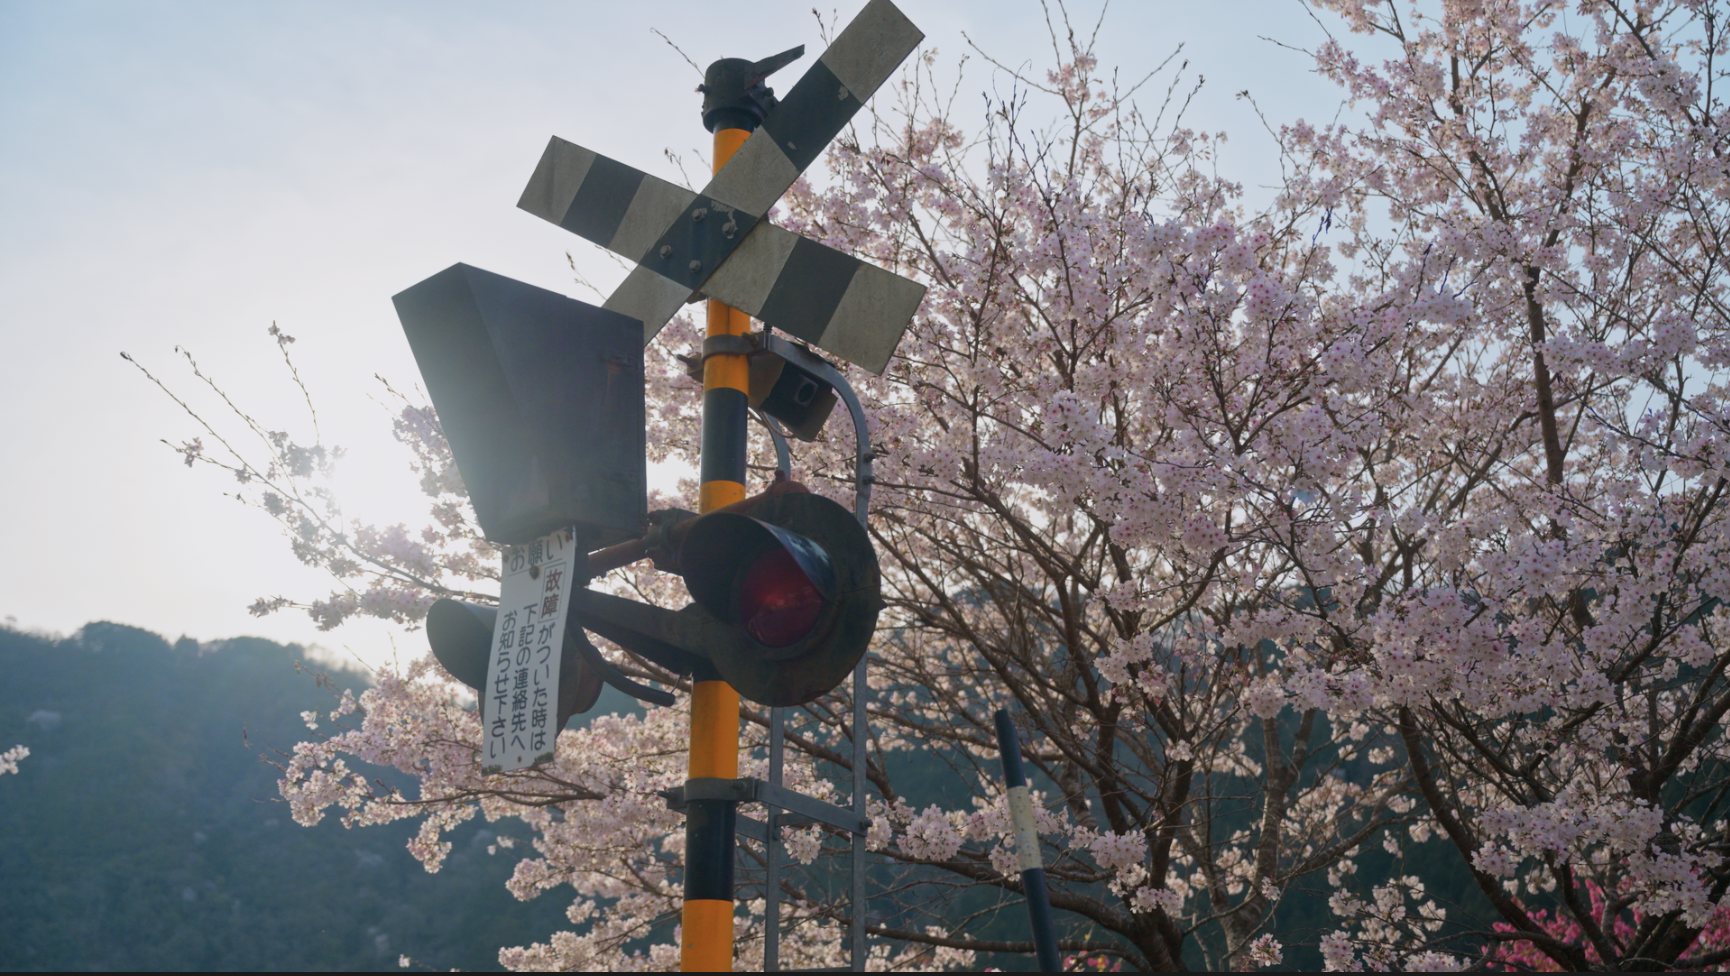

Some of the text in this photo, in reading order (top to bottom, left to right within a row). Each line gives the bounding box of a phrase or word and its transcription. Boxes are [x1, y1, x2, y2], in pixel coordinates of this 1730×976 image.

[510, 534, 563, 572] お願い
[489, 609, 517, 759] お知らせ下さい
[510, 602, 538, 751] 下記の連絡先へ
